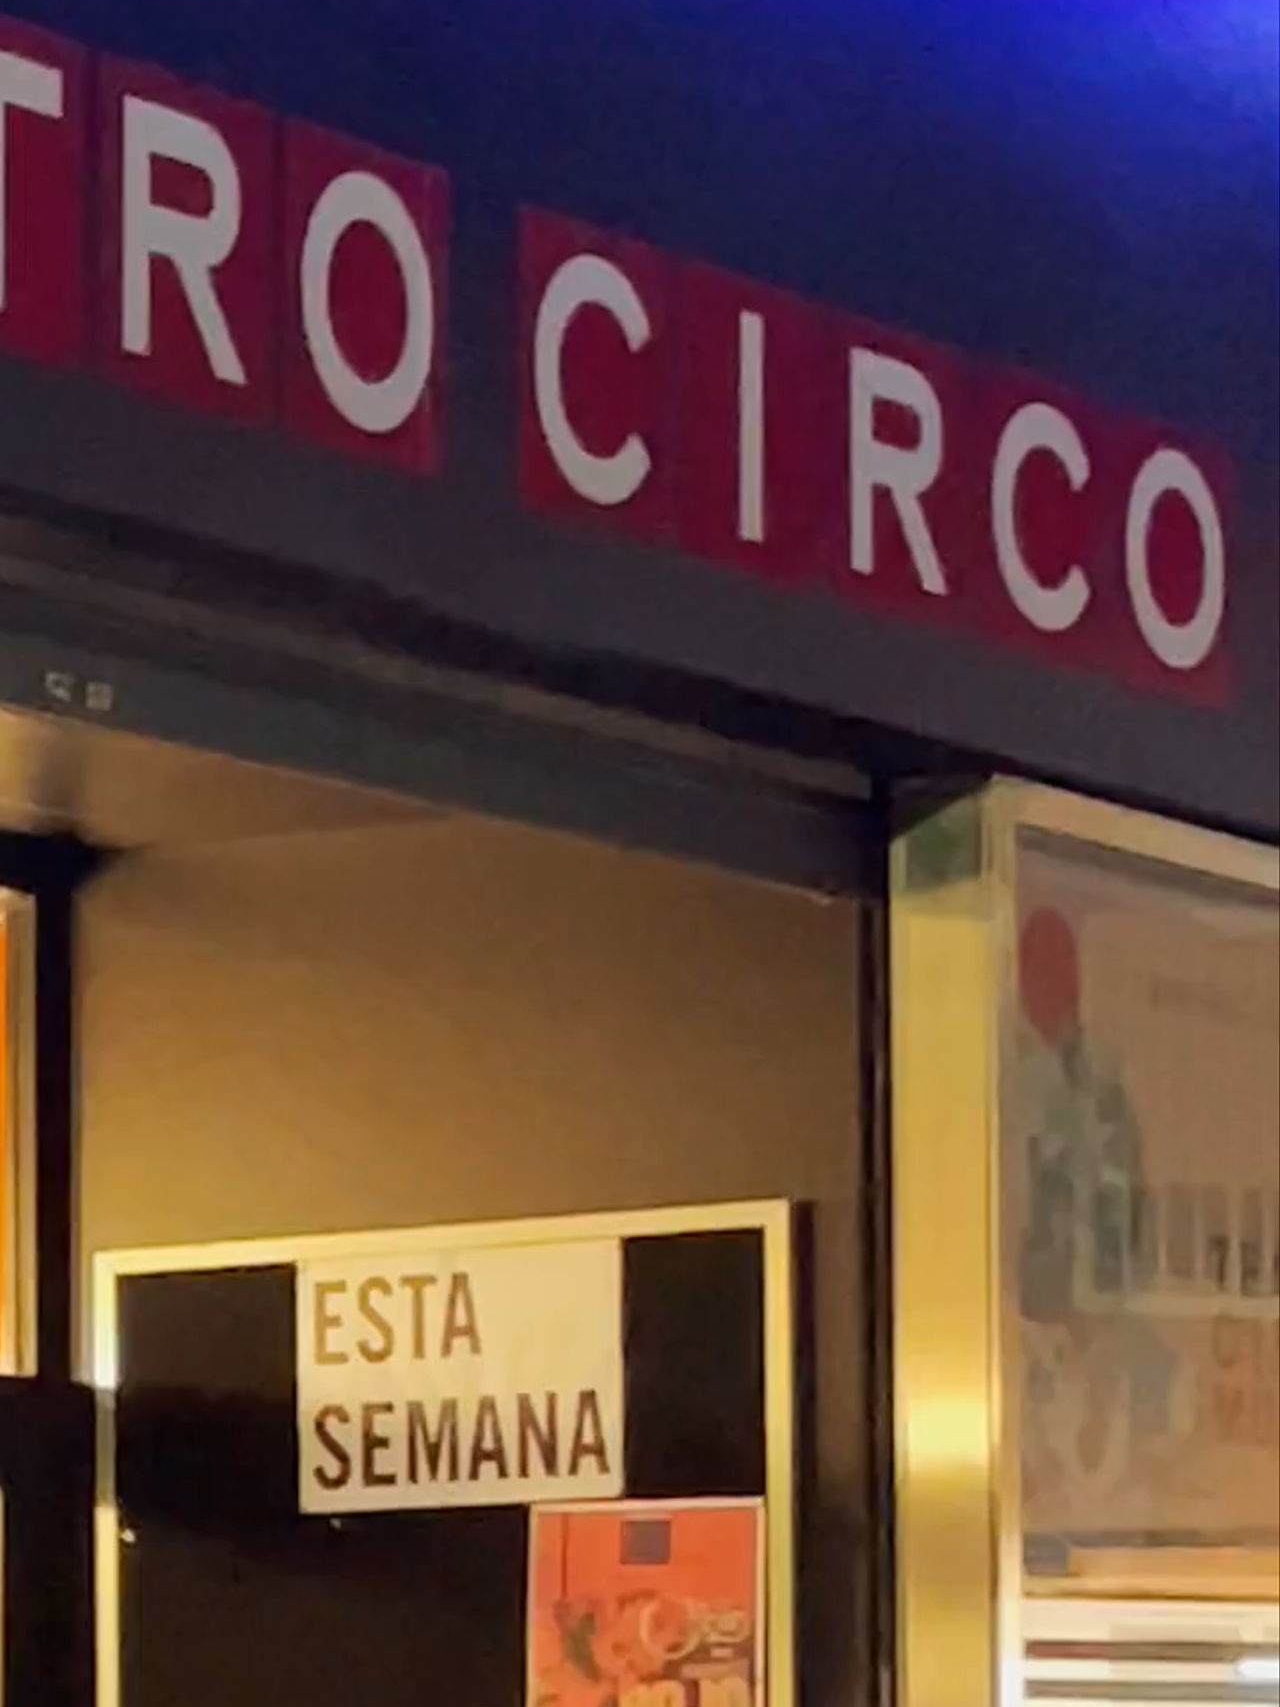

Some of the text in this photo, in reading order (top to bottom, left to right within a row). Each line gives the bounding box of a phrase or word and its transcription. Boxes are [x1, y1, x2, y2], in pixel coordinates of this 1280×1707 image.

[533, 250, 1228, 671] CIRCO
[313, 1272, 482, 1366] ESTA
[312, 1389, 611, 1491] SEMANA
